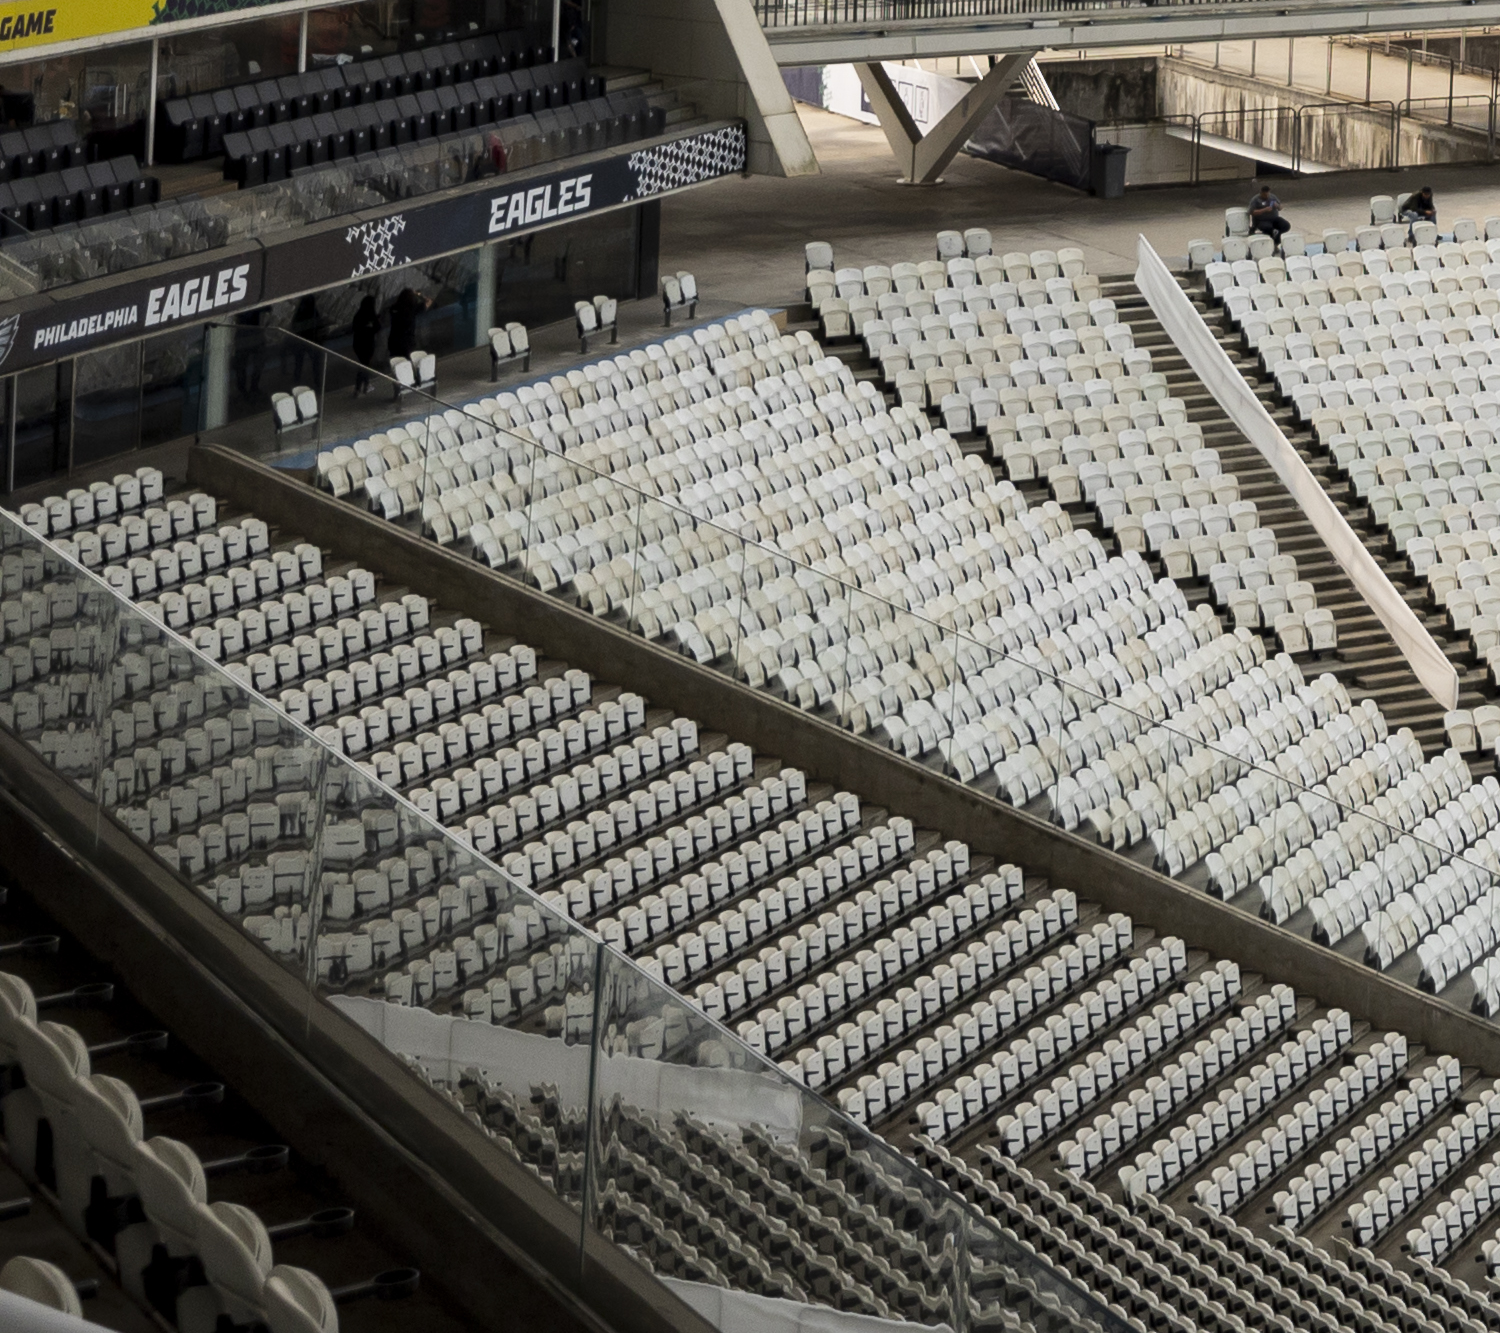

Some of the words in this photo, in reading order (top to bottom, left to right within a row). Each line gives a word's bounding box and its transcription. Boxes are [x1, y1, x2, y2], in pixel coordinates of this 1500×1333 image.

[0, 8, 57, 42] GAME
[488, 173, 593, 234] EAGLES
[33, 304, 139, 351] PHILADELPHIA
[144, 263, 250, 327] EAGLES
